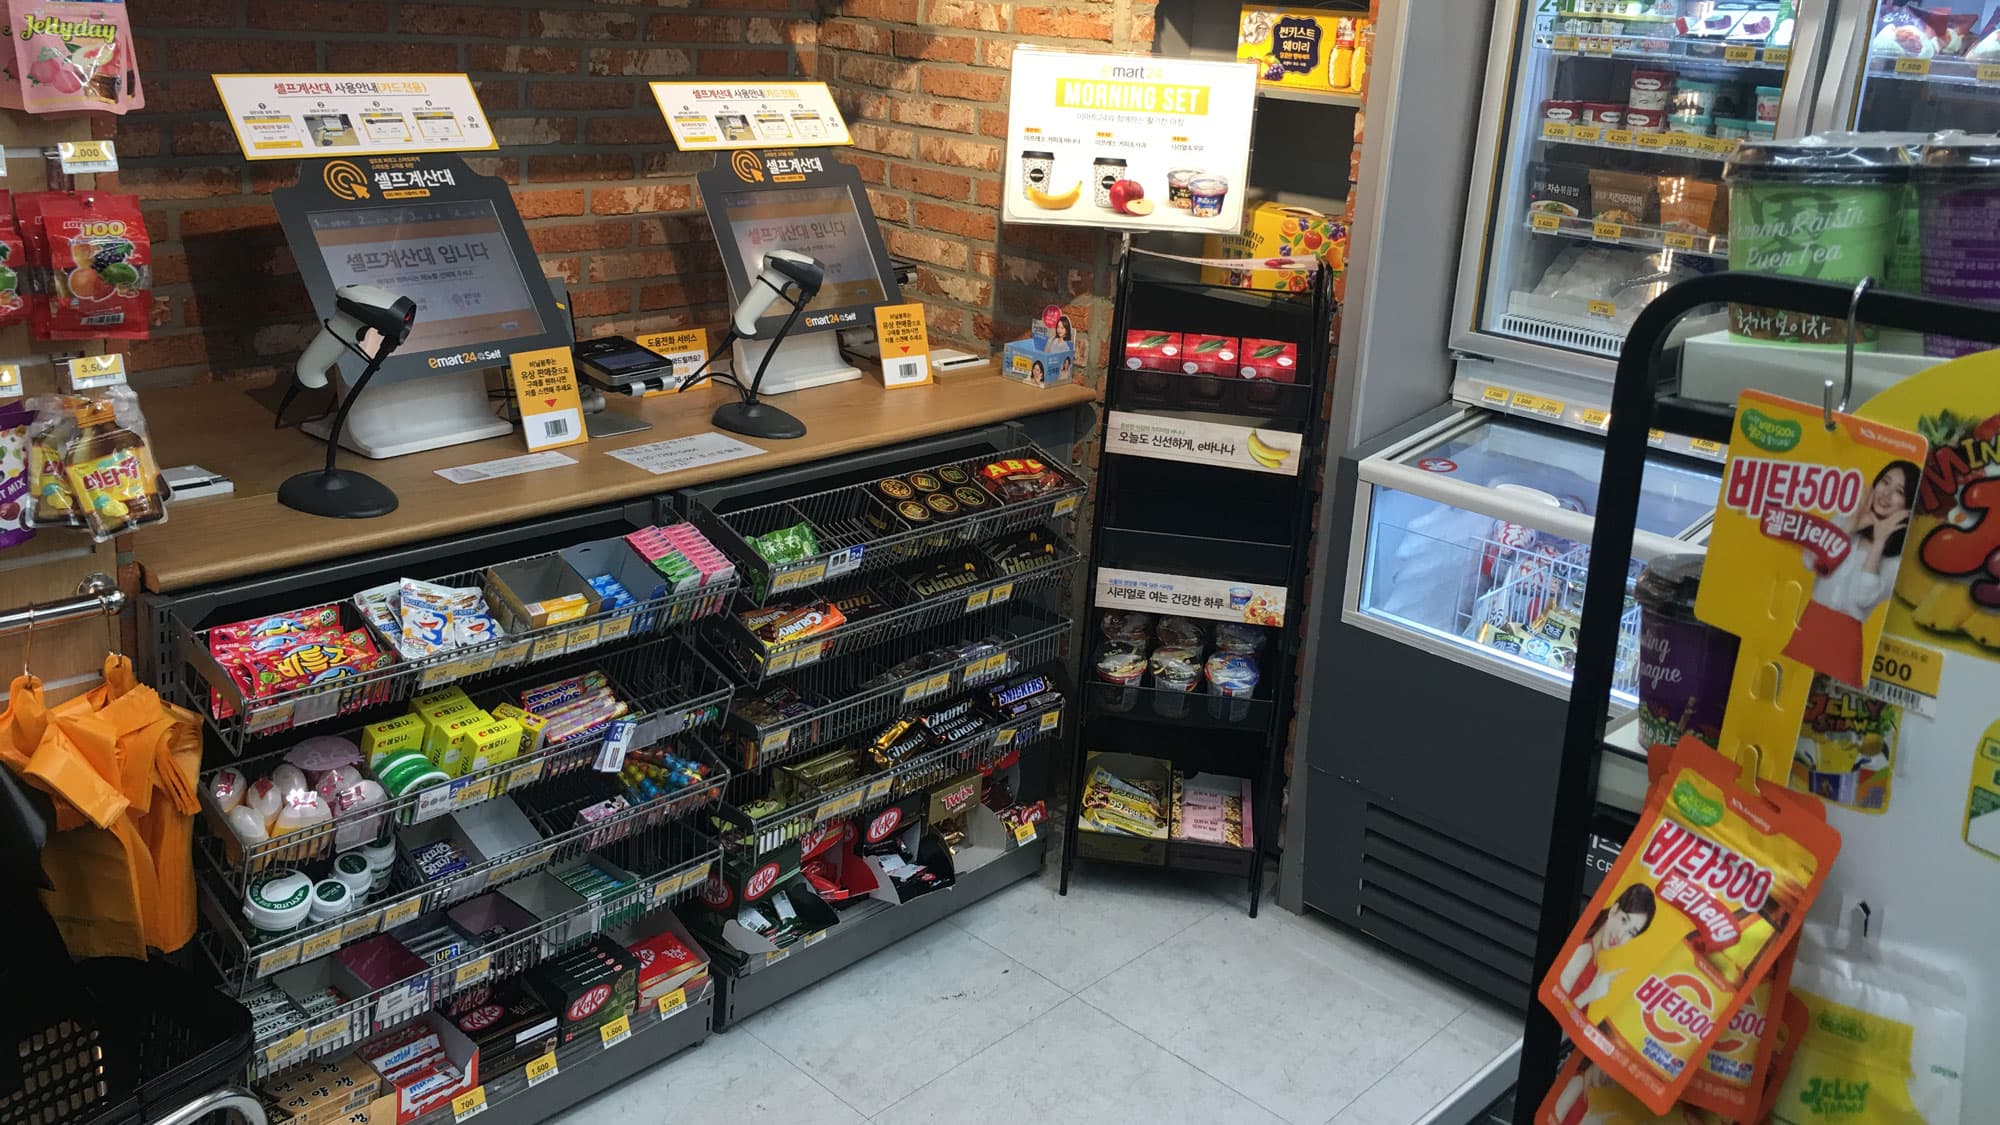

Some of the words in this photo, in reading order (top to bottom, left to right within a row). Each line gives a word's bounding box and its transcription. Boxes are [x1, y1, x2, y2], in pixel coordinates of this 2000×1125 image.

[21, 14, 117, 44] Jellyday
[1279, 26, 1316, 41] 썬키스트
[274, 82, 332, 95] 셀프계산대
[692, 88, 731, 99] 셀프계산대
[1064, 81, 1156, 110] MORNING
[1162, 87, 1200, 113] SET
[1610, 134, 1627, 142] 4,200
[1640, 137, 1658, 145] 4,200
[71, 147, 100, 158] ,000
[766, 157, 823, 175] 셀프계산대
[374, 168, 456, 189] 셀프계산대
[83, 222, 126, 237] 100
[1790, 201, 1865, 240] Raisin
[748, 224, 809, 244] 셀프계산대
[811, 220, 847, 237] 입니다
[346, 247, 437, 273] 셀프계산대
[437, 241, 490, 265] 입니다
[1746, 245, 1793, 271] Puer
[1799, 239, 1843, 264] Tea
[805, 313, 840, 328] emart24
[648, 336, 675, 347] 도움전화
[678, 333, 697, 343] 서비스
[428, 351, 478, 369] emart24
[521, 371, 535, 380] 유상
[537, 366, 568, 378] 판매중으로
[556, 384, 572, 392] 주세요
[1118, 431, 1149, 444] 오늘도
[1152, 435, 1195, 451] 신선하게,
[1198, 441, 1235, 455] e바나나
[989, 459, 1044, 479] ABC
[7, 477, 27, 493] MIX
[1727, 458, 1861, 516] 비타500
[1765, 510, 1802, 541] 젤리
[1801, 522, 1848, 557] jelly
[1001, 553, 1053, 575] Ghana
[917, 570, 979, 596] Ghana
[1107, 587, 1146, 600] 시리얼로
[1149, 591, 1169, 603] 여는
[1171, 593, 1202, 607] 건강한
[1204, 597, 1225, 609] 하루
[1000, 677, 1045, 705] SNICKERS
[443, 704, 466, 716] 레모나
[926, 702, 969, 728] Ghana
[1804, 693, 1883, 722] JELLY
[387, 719, 411, 731] 레모나
[459, 716, 482, 727] 레모나
[487, 723, 510, 735] 레모나
[948, 718, 985, 742] Ghana
[387, 734, 409, 746] 레모나
[488, 738, 510, 749] 레모나
[887, 731, 925, 760] Ghana
[942, 784, 974, 811] Twix
[1641, 820, 1773, 910] 비타500
[1660, 876, 1700, 910] 젤리
[1692, 898, 1739, 944] jelly
[572, 986, 606, 1017] KitKat
[1634, 976, 1715, 1041] 비타500
[462, 1006, 500, 1030] KitKat
[1800, 1077, 1870, 1104] JELLY
[461, 1097, 474, 1109] 700
